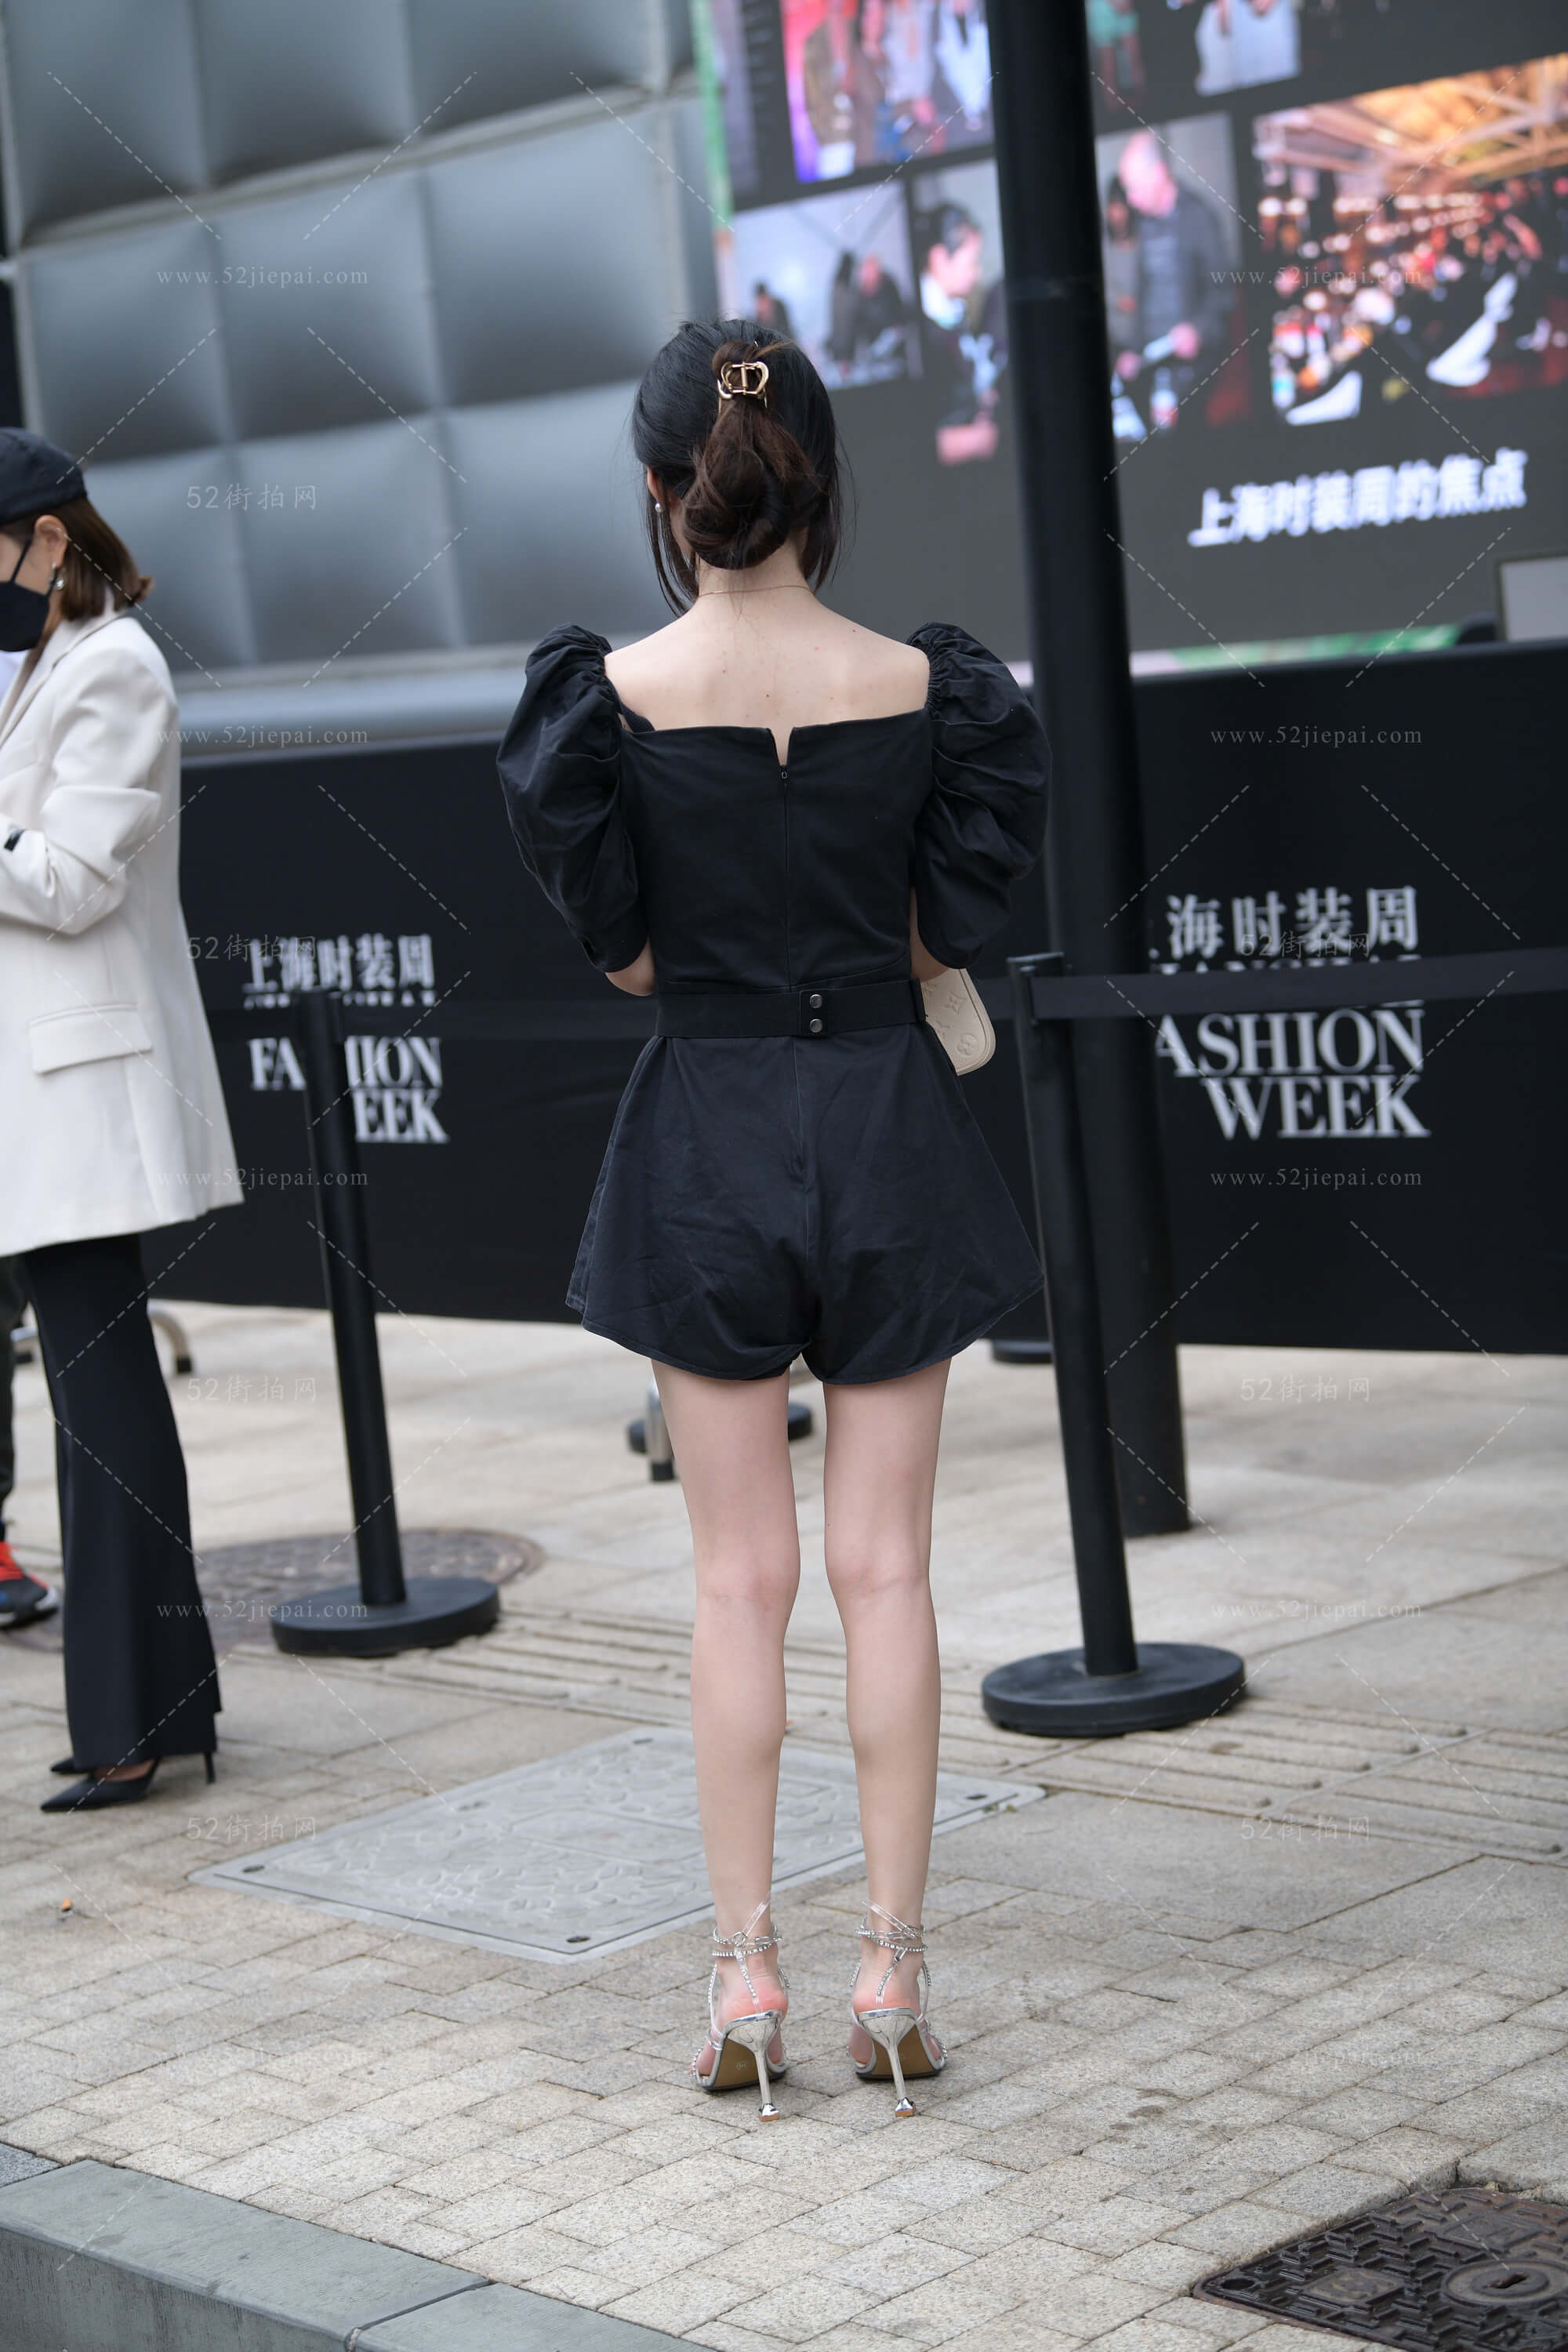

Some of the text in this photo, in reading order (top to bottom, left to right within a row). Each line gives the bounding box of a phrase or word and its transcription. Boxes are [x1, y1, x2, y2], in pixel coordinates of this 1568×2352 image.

[1149, 885, 1418, 959] 海时装周
[246, 1035, 444, 1091] FAION
[1155, 1008, 1425, 1078] ASHION
[353, 1087, 450, 1144] EEK
[1200, 1073, 1432, 1142] WEEK
